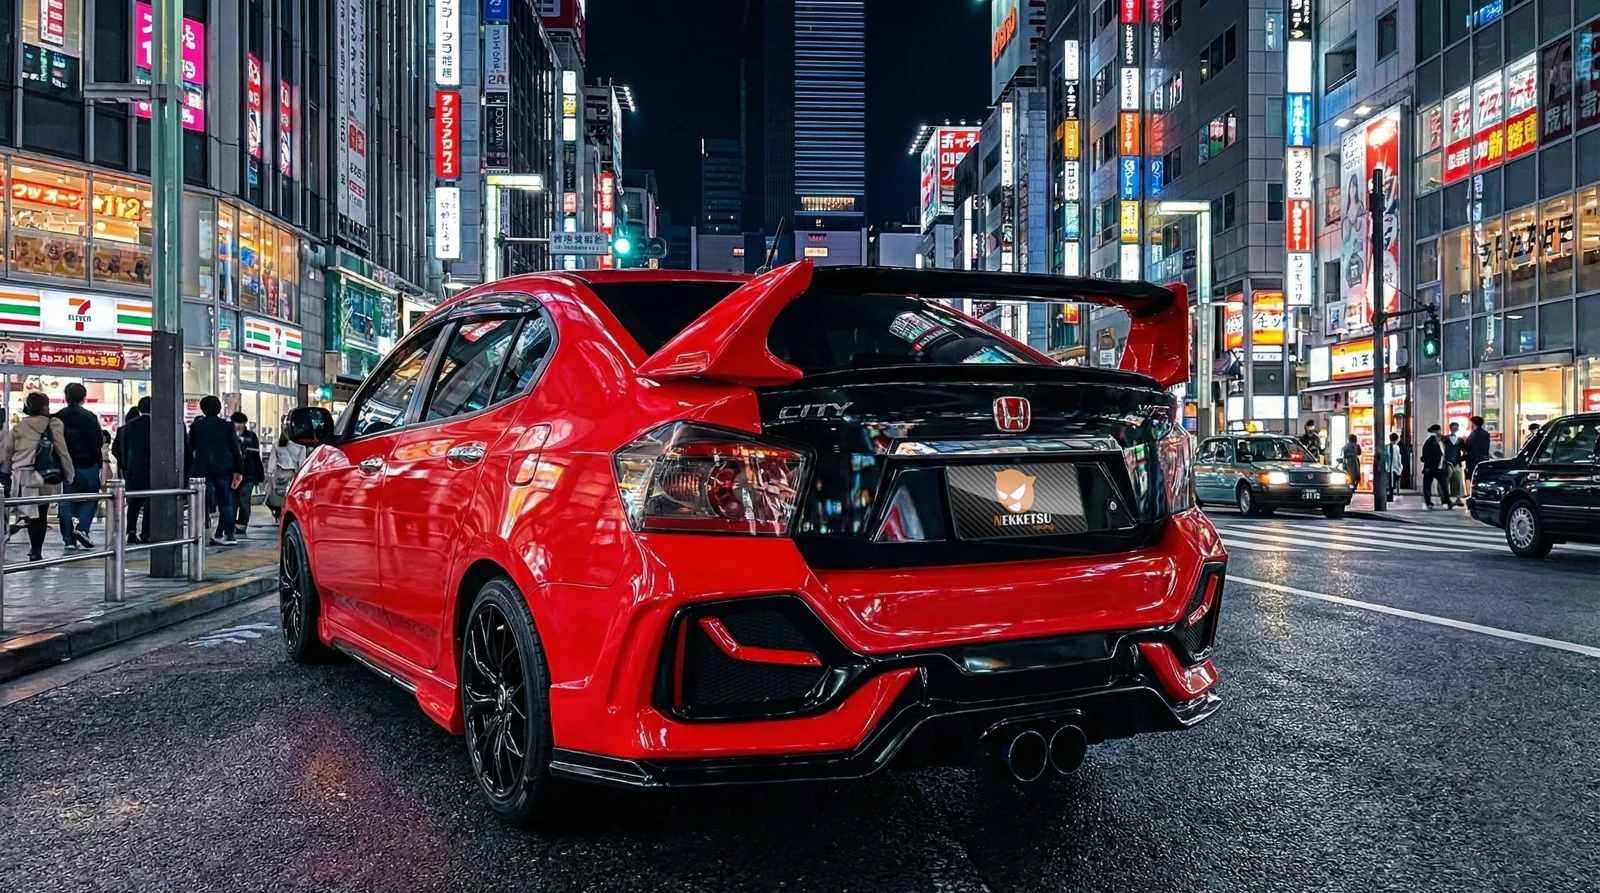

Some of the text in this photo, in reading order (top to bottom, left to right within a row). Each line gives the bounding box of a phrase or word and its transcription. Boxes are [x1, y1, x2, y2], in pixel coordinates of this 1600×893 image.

[778, 401, 854, 419] CITY
[993, 512, 1052, 527] NEKKETSU
[1032, 523, 1055, 531] racing
